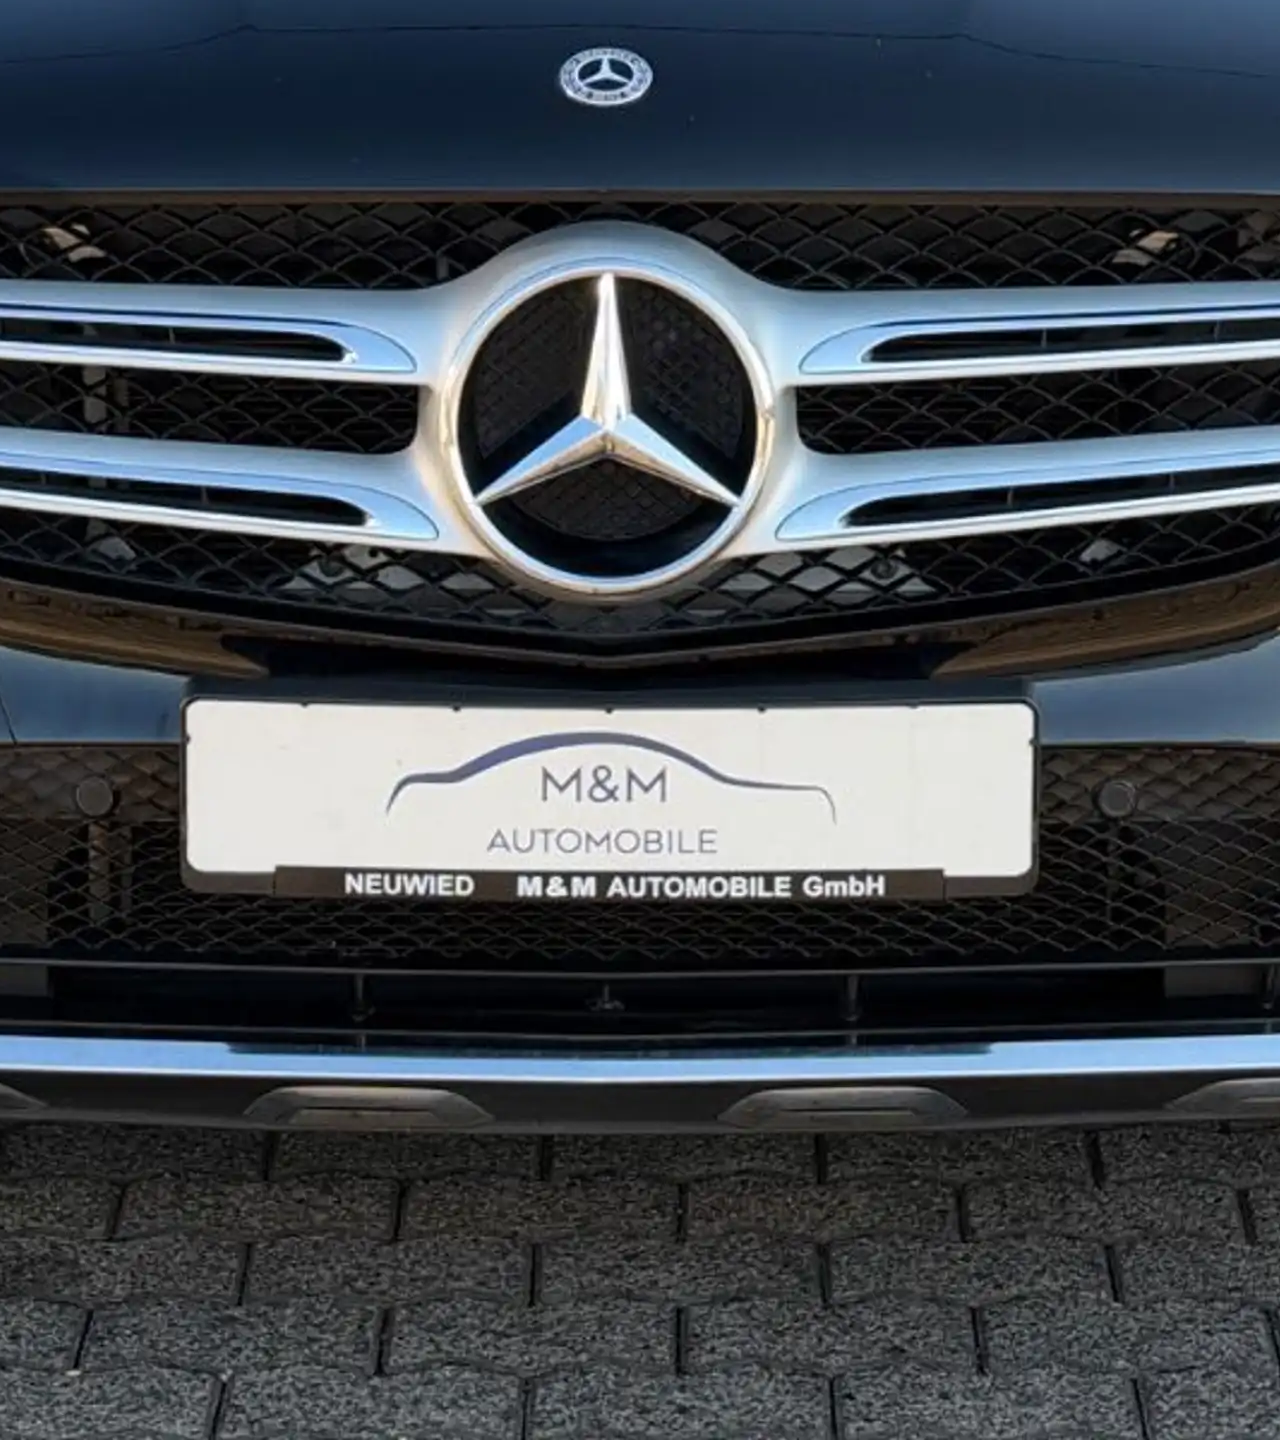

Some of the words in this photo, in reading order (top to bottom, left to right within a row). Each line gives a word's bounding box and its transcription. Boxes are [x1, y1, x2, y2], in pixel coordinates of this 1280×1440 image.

[540, 765, 668, 805] M&M
[486, 827, 719, 855] AUTOMOBILE
[344, 872, 476, 898] NEUWIED
[517, 874, 597, 899] M&M
[608, 875, 792, 900] AUTOMOBILE
[802, 874, 887, 898] GmbH
